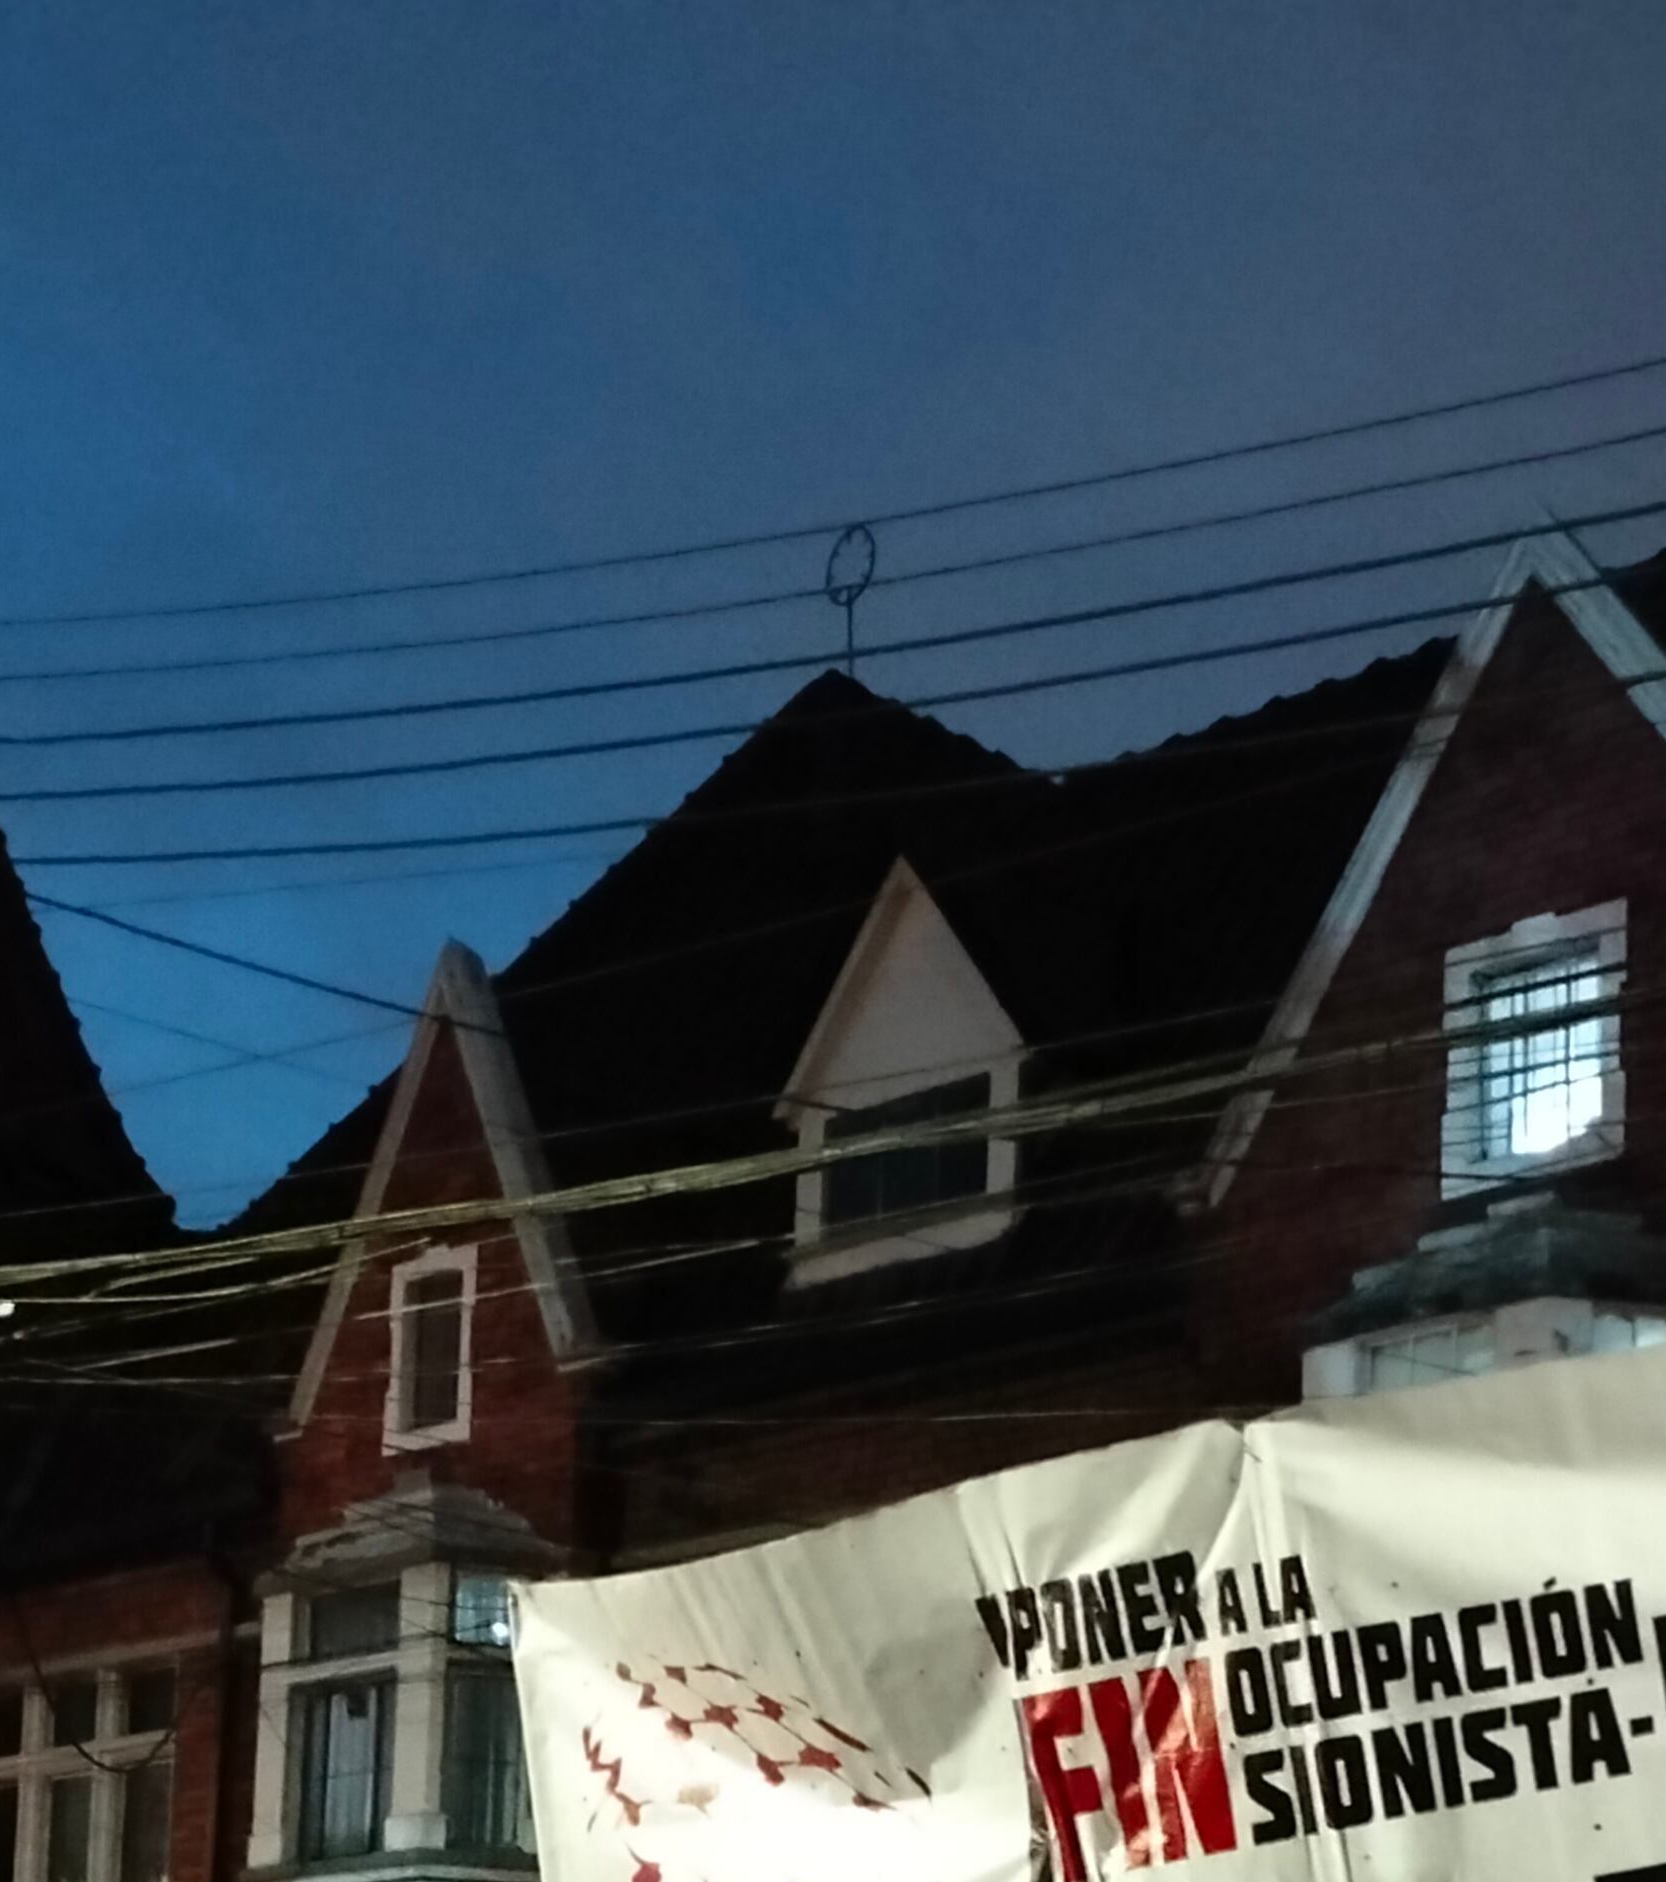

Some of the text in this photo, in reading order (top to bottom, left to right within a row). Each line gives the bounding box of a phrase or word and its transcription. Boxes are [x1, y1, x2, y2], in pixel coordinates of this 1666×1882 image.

[1216, 1567, 1247, 1636] A
[1253, 1554, 1317, 1625] LA
[1226, 1577, 1645, 1736] OCUPACIÓN
